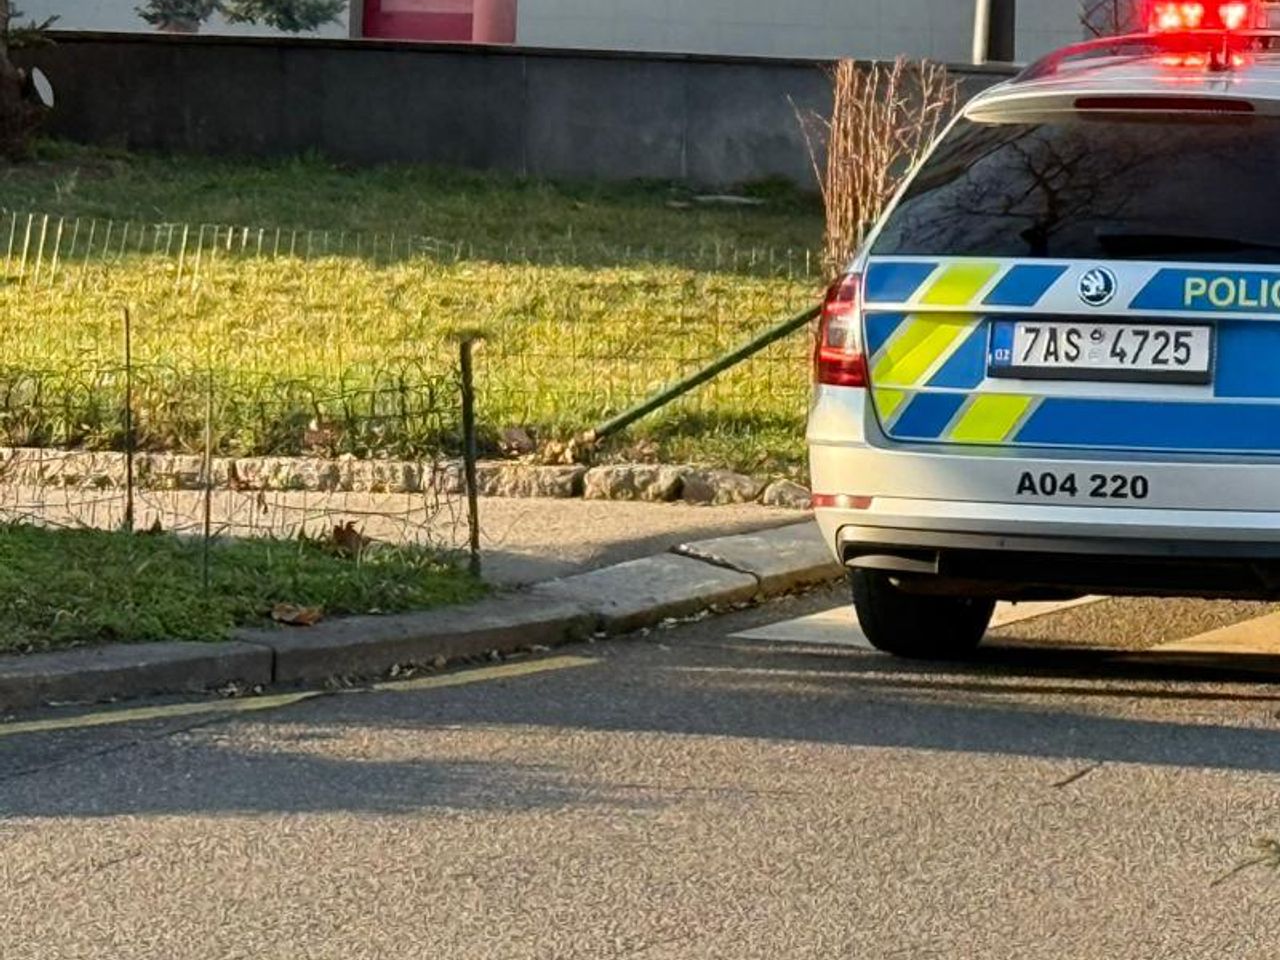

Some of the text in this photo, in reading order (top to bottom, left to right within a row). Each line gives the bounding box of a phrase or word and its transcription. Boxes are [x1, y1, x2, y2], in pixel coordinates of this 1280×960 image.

[1022, 326, 1193, 366] 7AS 4725
[1015, 471, 1149, 500] A04 220
